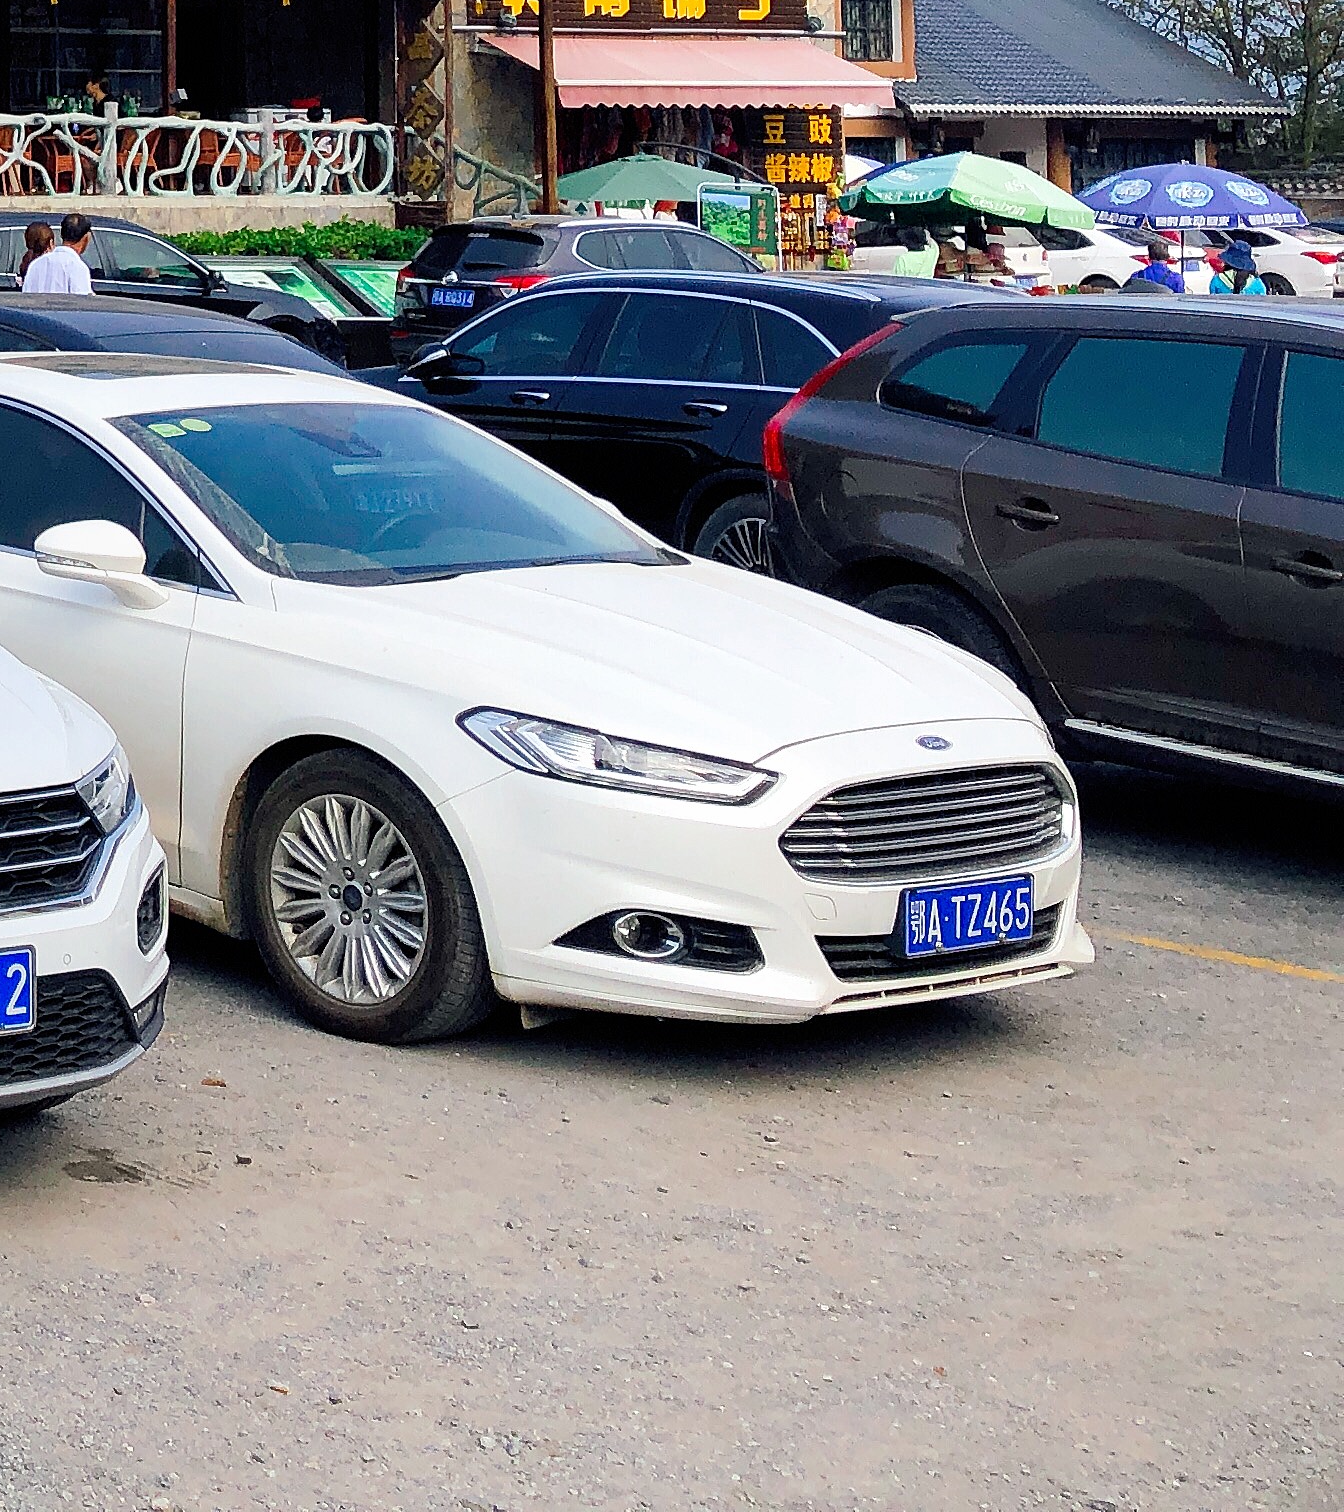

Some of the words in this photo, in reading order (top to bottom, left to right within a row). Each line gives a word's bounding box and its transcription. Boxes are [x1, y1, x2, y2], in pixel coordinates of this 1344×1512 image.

[763, 114, 832, 144] 豆豉
[765, 153, 833, 183] 酱辣椒
